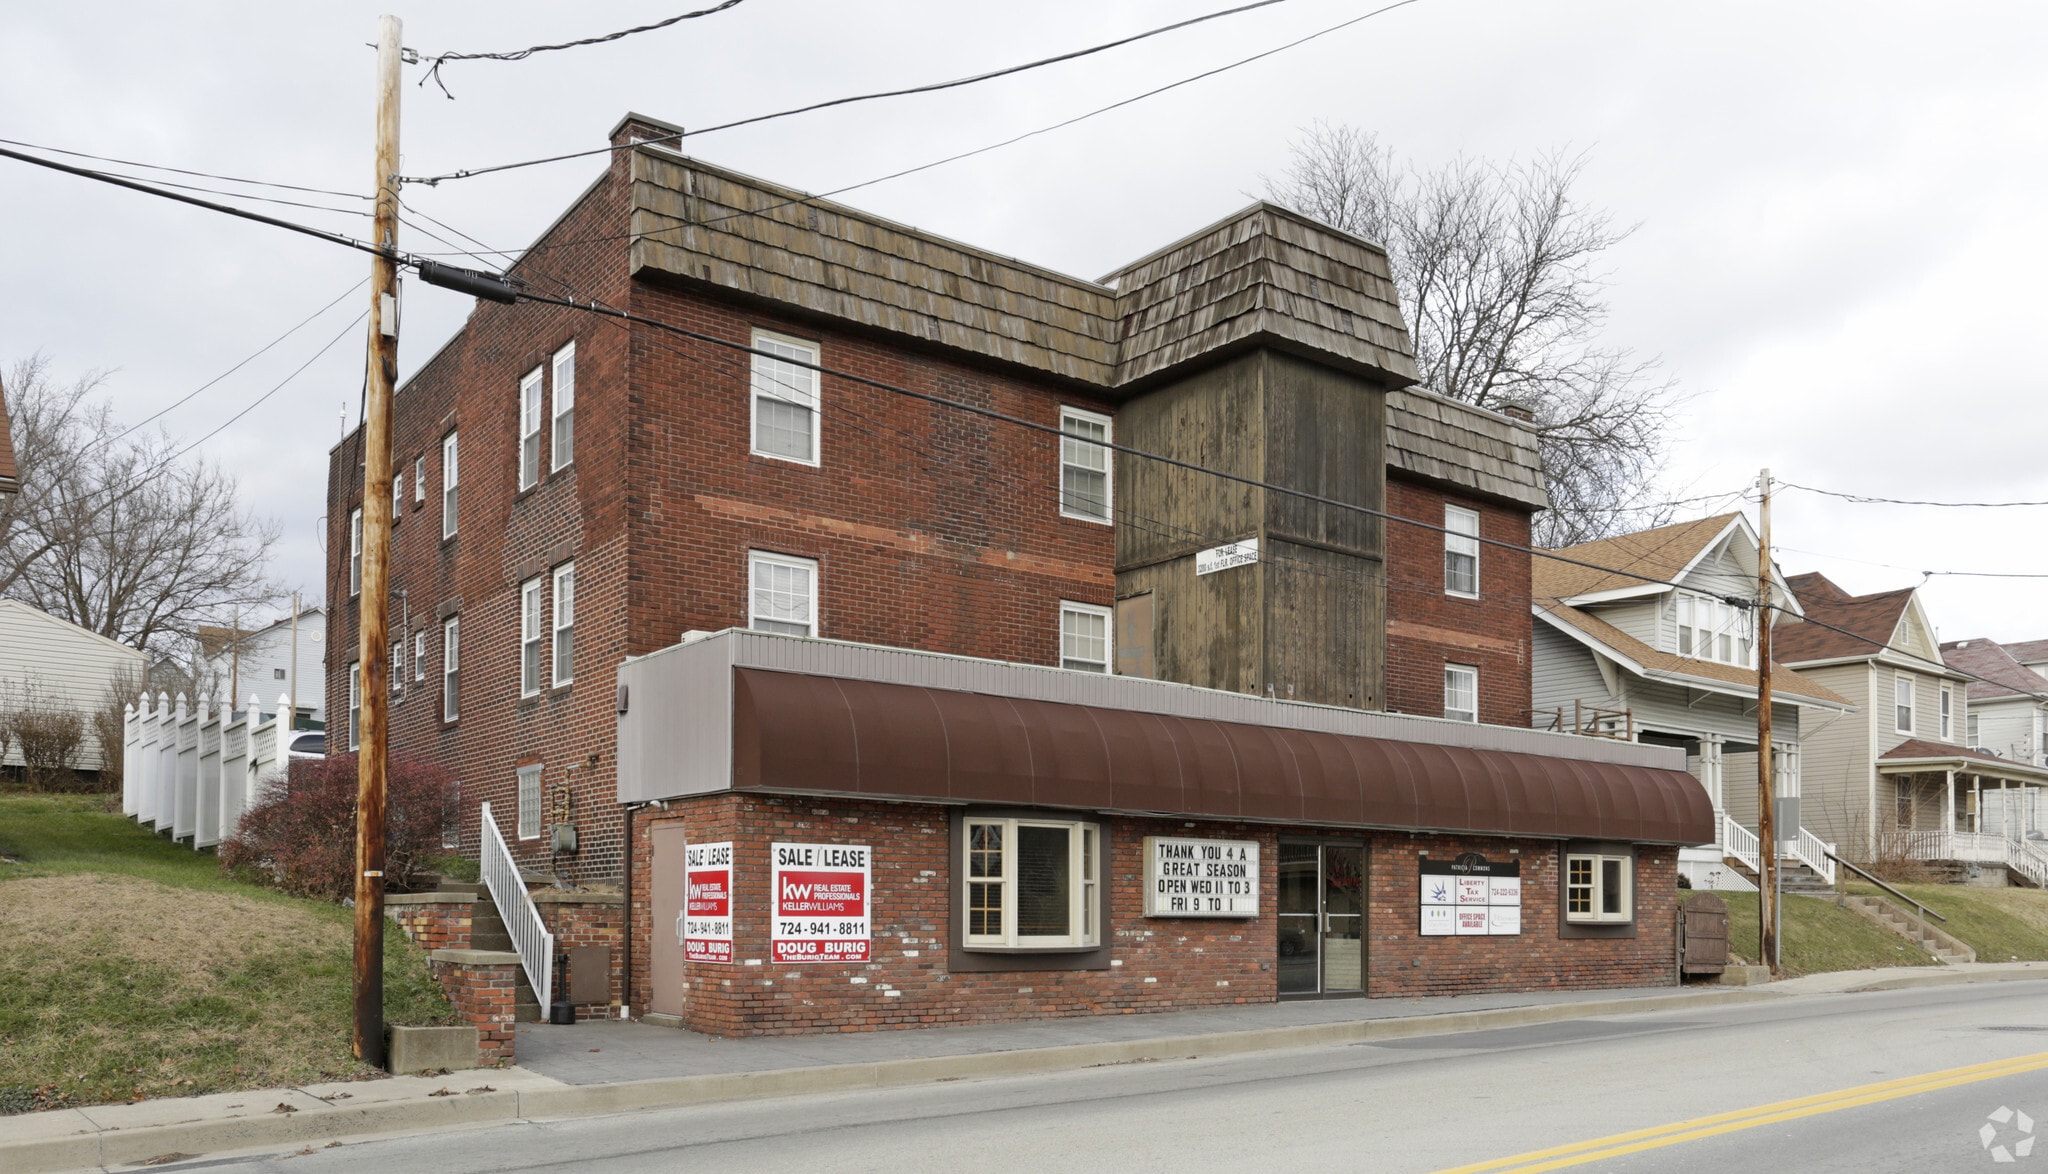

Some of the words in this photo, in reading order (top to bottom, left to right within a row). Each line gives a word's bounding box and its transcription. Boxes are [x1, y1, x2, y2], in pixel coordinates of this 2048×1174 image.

[1225, 545, 1237, 556] LEASE
[688, 850, 703, 866] SALE
[708, 848, 730, 865] LEASE
[779, 848, 812, 866] SALE
[824, 850, 865, 867] LEASE
[1159, 844, 1194, 859] THANK
[1202, 846, 1221, 860] YOU
[1227, 848, 1233, 860] 4
[1240, 848, 1246, 860] A
[1164, 862, 1200, 876] GREAT
[1207, 864, 1246, 877] SEASON
[690, 878, 702, 900] kw
[782, 876, 813, 900] kw
[814, 884, 829, 892] REAL
[830, 884, 851, 892] ESTATE
[1158, 880, 1186, 893] OPEN
[1191, 880, 1211, 894] WED
[1228, 881, 1240, 894] TO
[1244, 882, 1250, 894] 3
[814, 893, 860, 901] PROFESSIONALS
[1172, 897, 1187, 911] FRI
[1194, 898, 1199, 911] 9
[1208, 898, 1221, 911] TO
[686, 941, 705, 952] DOUG
[708, 942, 729, 954] BURIG
[777, 942, 817, 954] DOUG
[824, 942, 866, 953] BURIG
